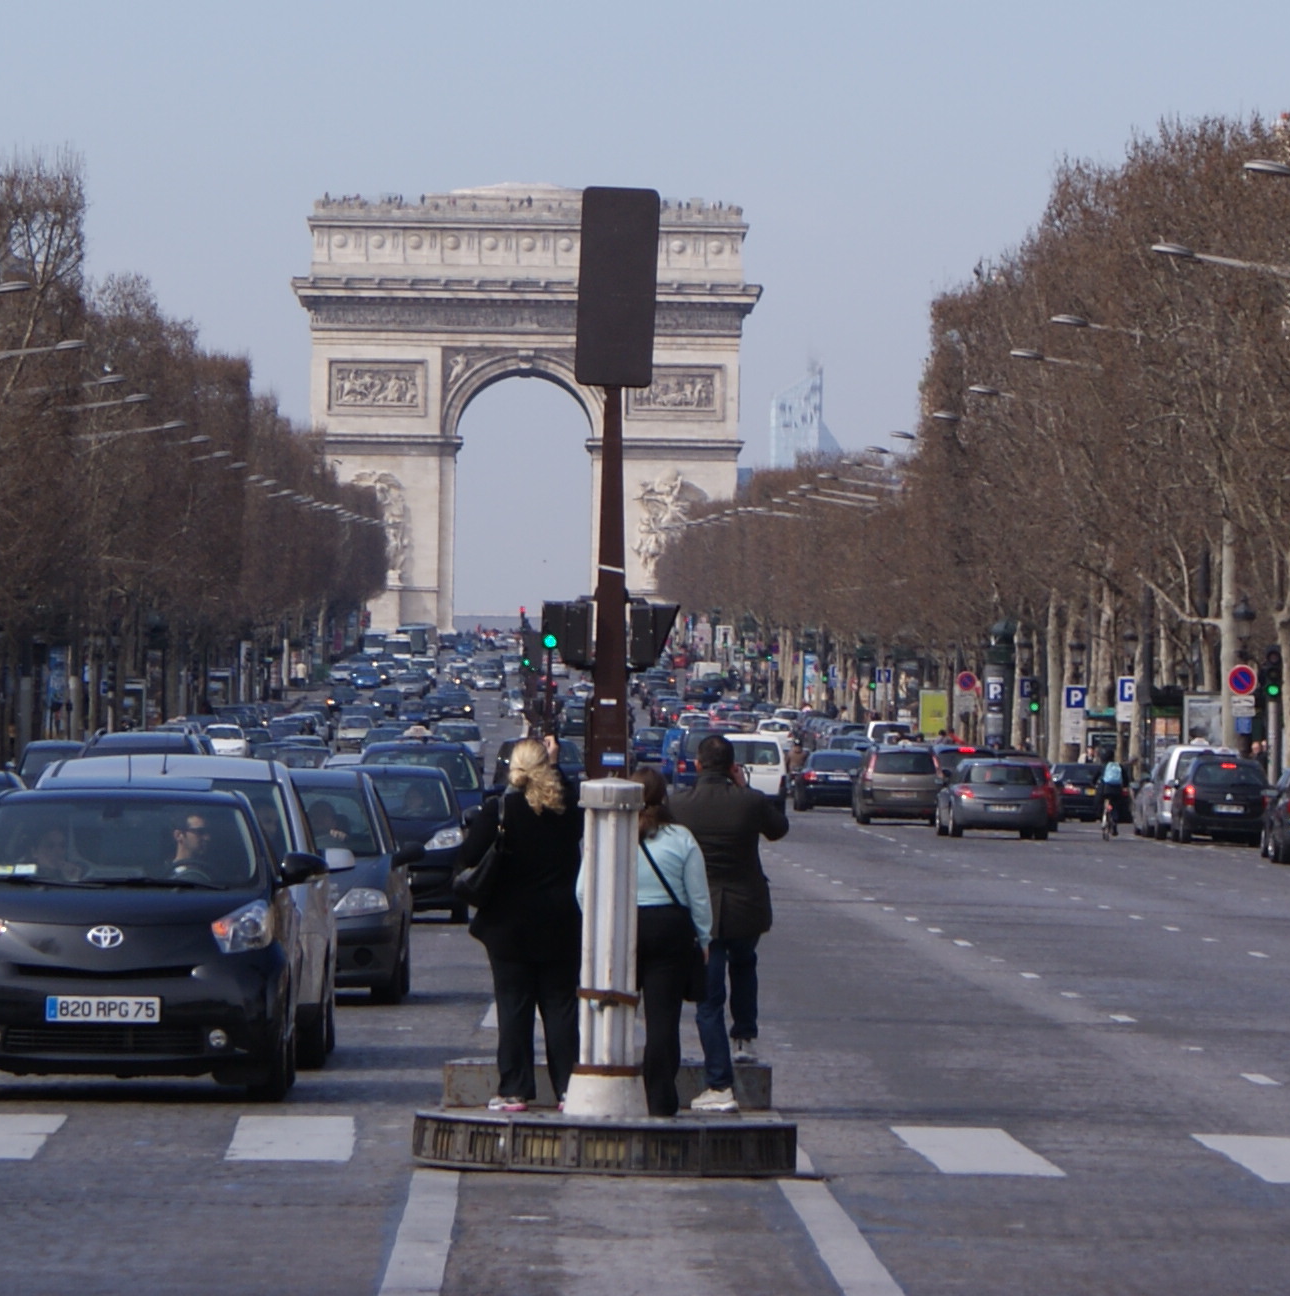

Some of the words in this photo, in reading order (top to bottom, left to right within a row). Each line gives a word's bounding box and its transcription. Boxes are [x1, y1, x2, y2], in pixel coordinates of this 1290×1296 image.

[1071, 690, 1083, 706] P
[1124, 682, 1134, 699] P
[59, 1000, 91, 1017] 820
[96, 1001, 129, 1018] RPG
[133, 1001, 156, 1018] 75
